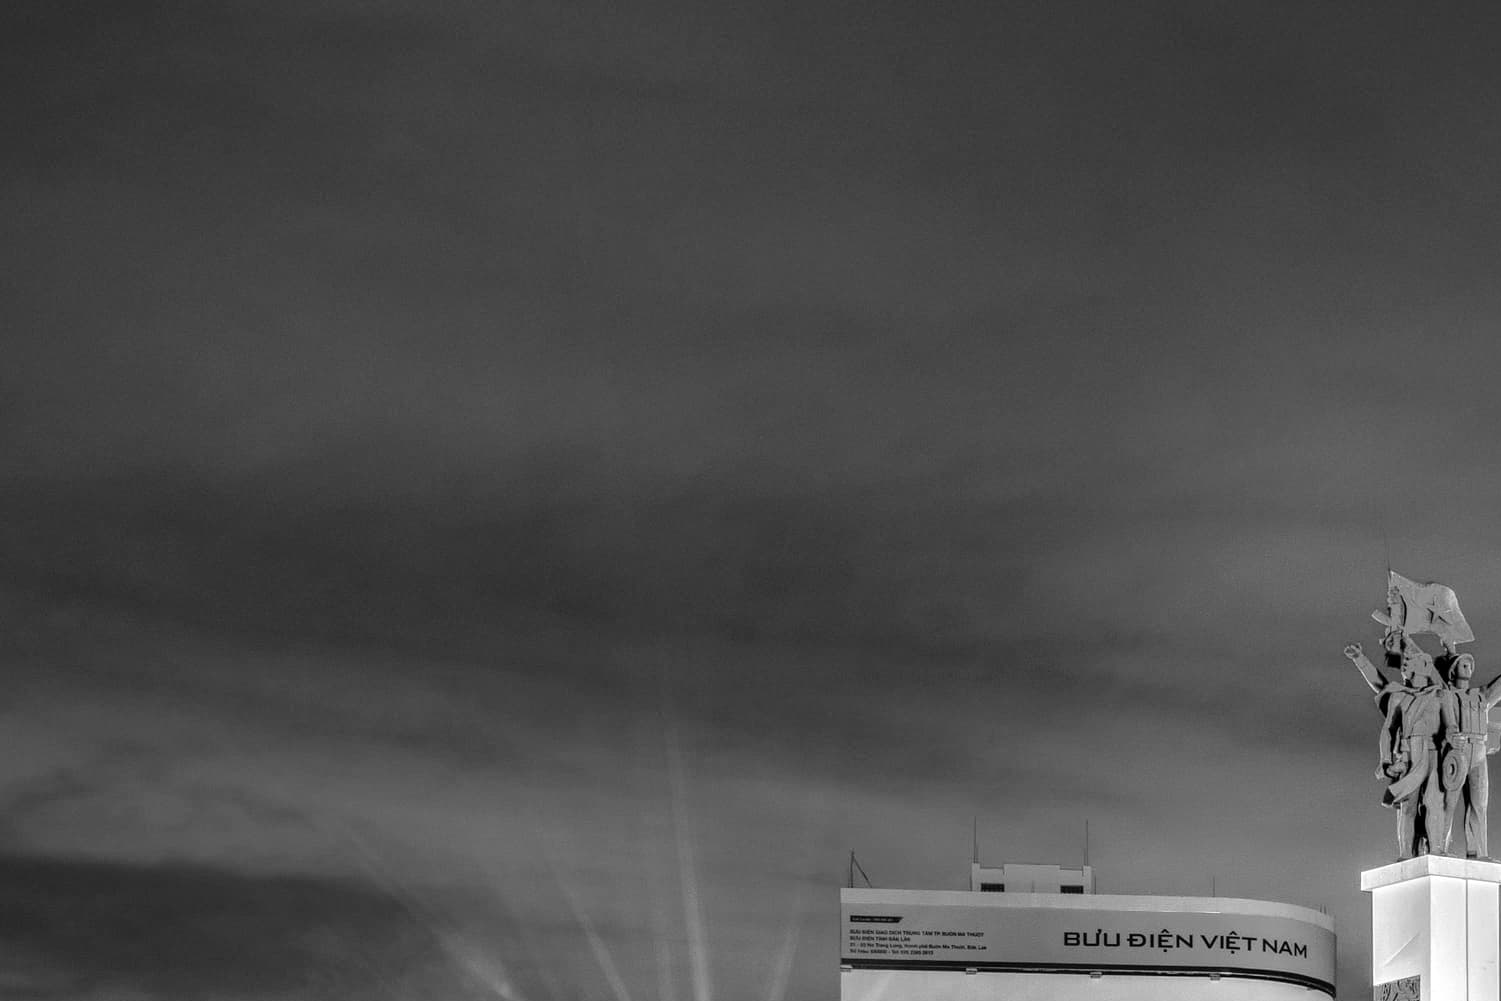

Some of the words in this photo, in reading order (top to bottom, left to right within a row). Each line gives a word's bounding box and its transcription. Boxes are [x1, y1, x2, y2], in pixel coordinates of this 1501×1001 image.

[1063, 928, 1120, 947] BƯU
[1127, 929, 1194, 952] ĐIỆN
[1201, 931, 1257, 954] VIỆT
[1262, 938, 1307, 959] NAM
